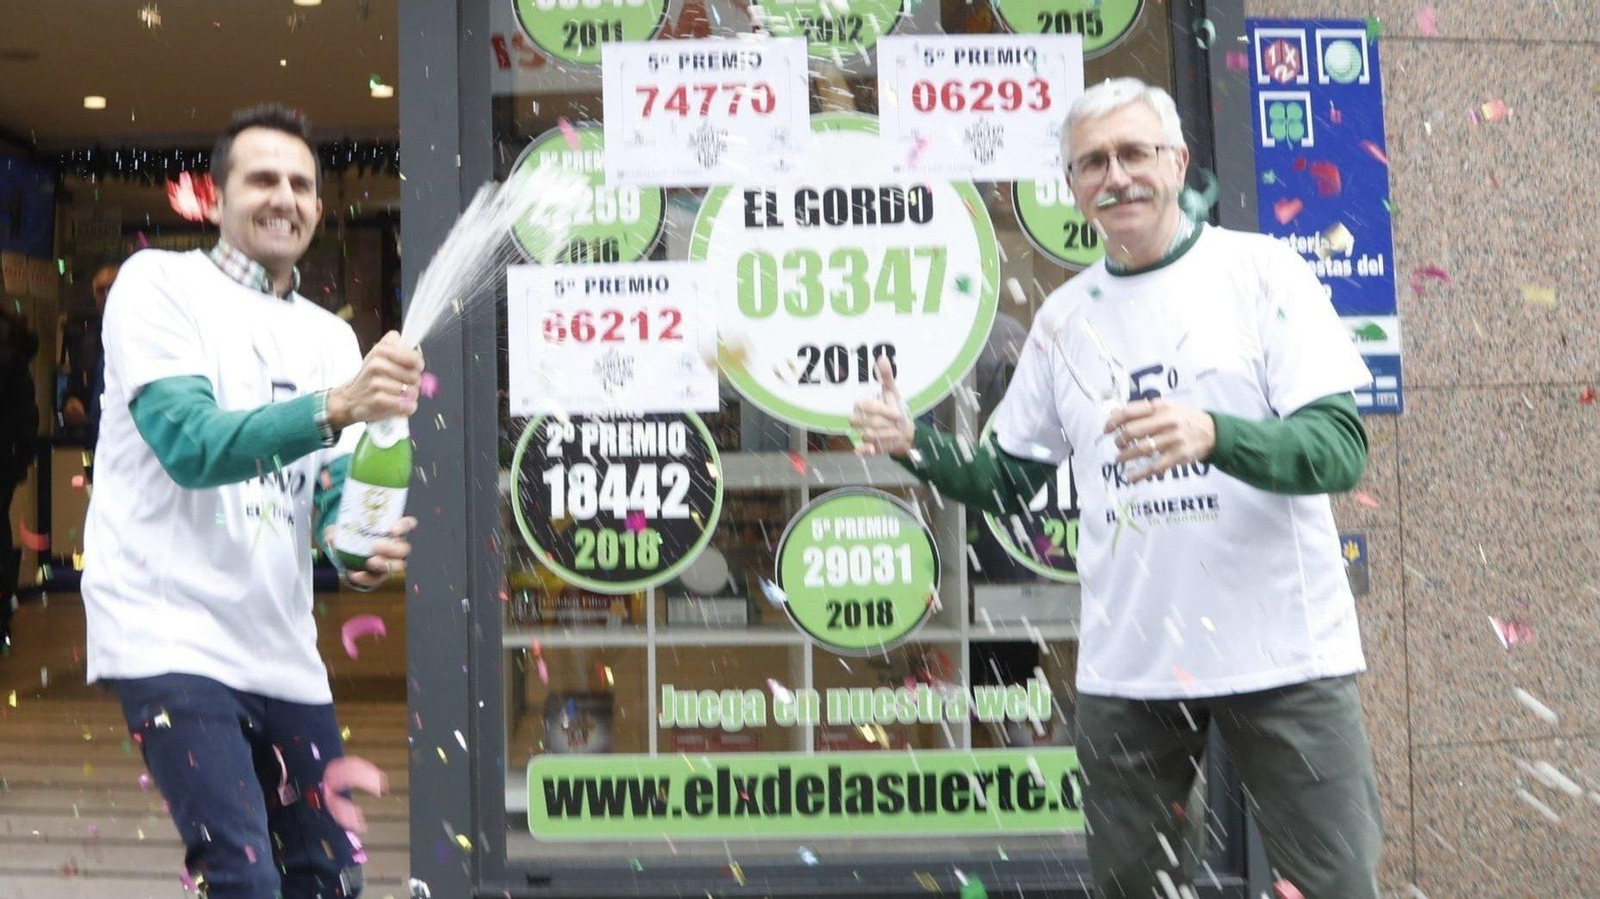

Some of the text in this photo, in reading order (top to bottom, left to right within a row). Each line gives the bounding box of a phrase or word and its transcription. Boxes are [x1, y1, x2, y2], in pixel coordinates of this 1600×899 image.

[562, 19, 623, 50] 2011
[1037, 9, 1104, 38] 2015
[678, 49, 763, 70] PREMIO
[953, 45, 1038, 67] PREMIO
[635, 79, 777, 118] 74770
[910, 75, 1053, 113] 06293
[743, 184, 935, 229] EL GORDO
[1062, 220, 1099, 250] 20
[736, 245, 948, 320] 03347
[1356, 253, 1385, 277] del
[584, 274, 670, 296] PREMIO
[541, 307, 684, 344] 66212
[796, 342, 898, 387] 2018
[581, 420, 687, 458] PREMIO
[542, 461, 692, 521] 18442
[834, 515, 901, 541] PREMIO
[574, 527, 661, 571] 2018
[802, 541, 913, 589] 29031
[826, 597, 895, 630] 2018
[658, 677, 1053, 734] Juega en nuestra web
